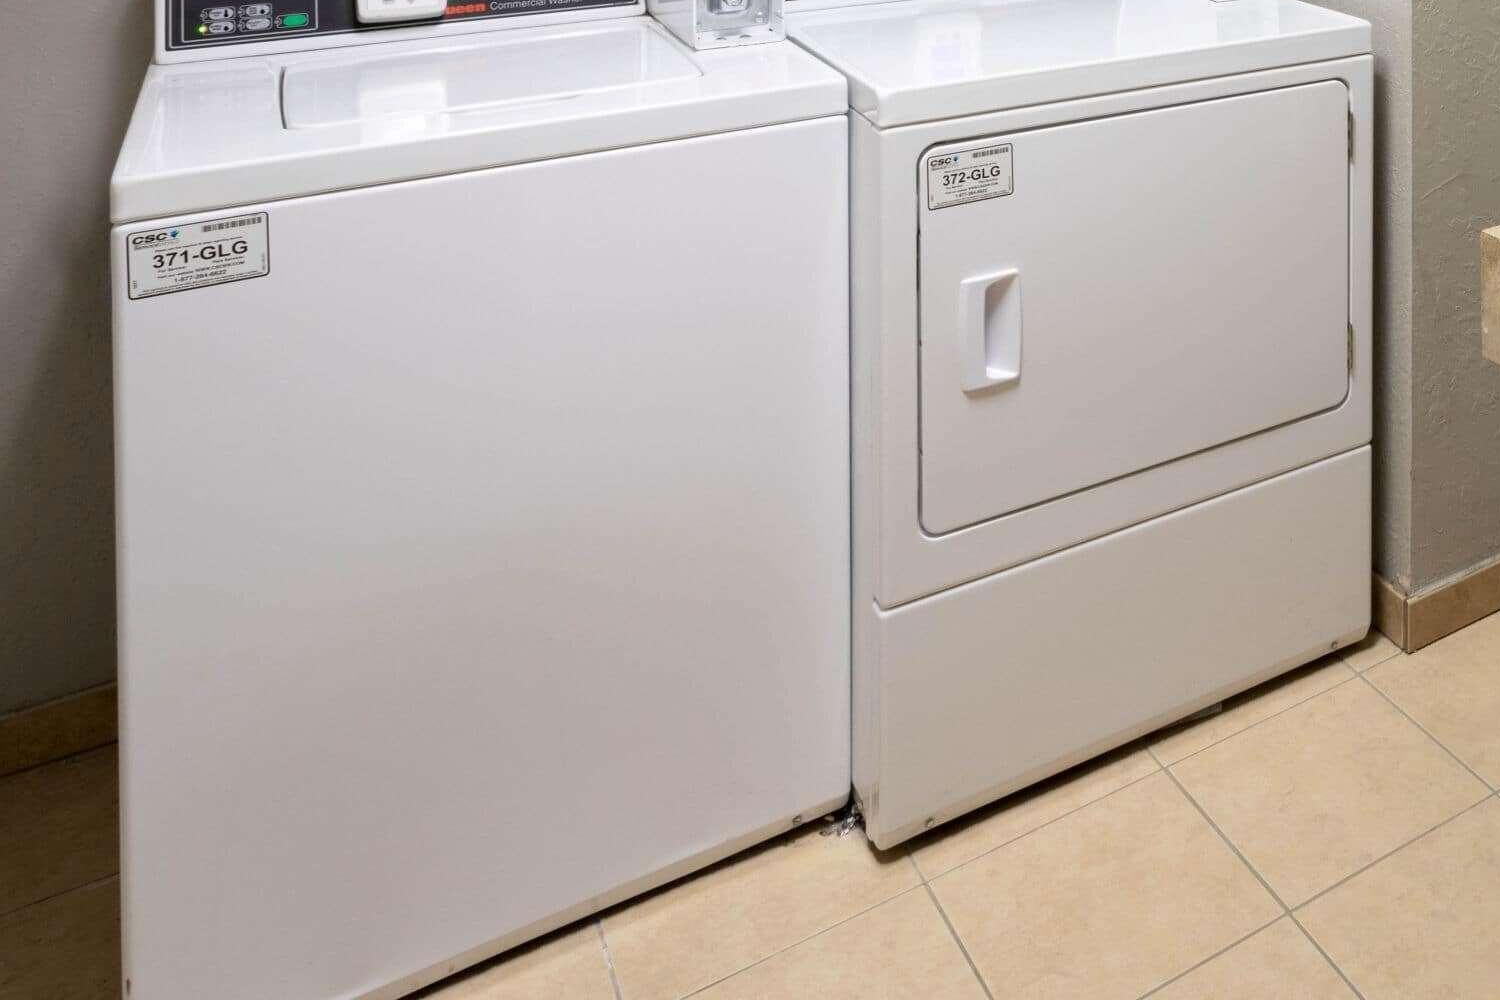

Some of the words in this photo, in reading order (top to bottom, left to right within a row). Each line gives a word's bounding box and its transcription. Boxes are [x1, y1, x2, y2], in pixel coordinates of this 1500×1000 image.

[942, 165, 1001, 186] 372-GLG
[132, 231, 168, 245] CSC
[152, 240, 249, 269] 371-GLG
